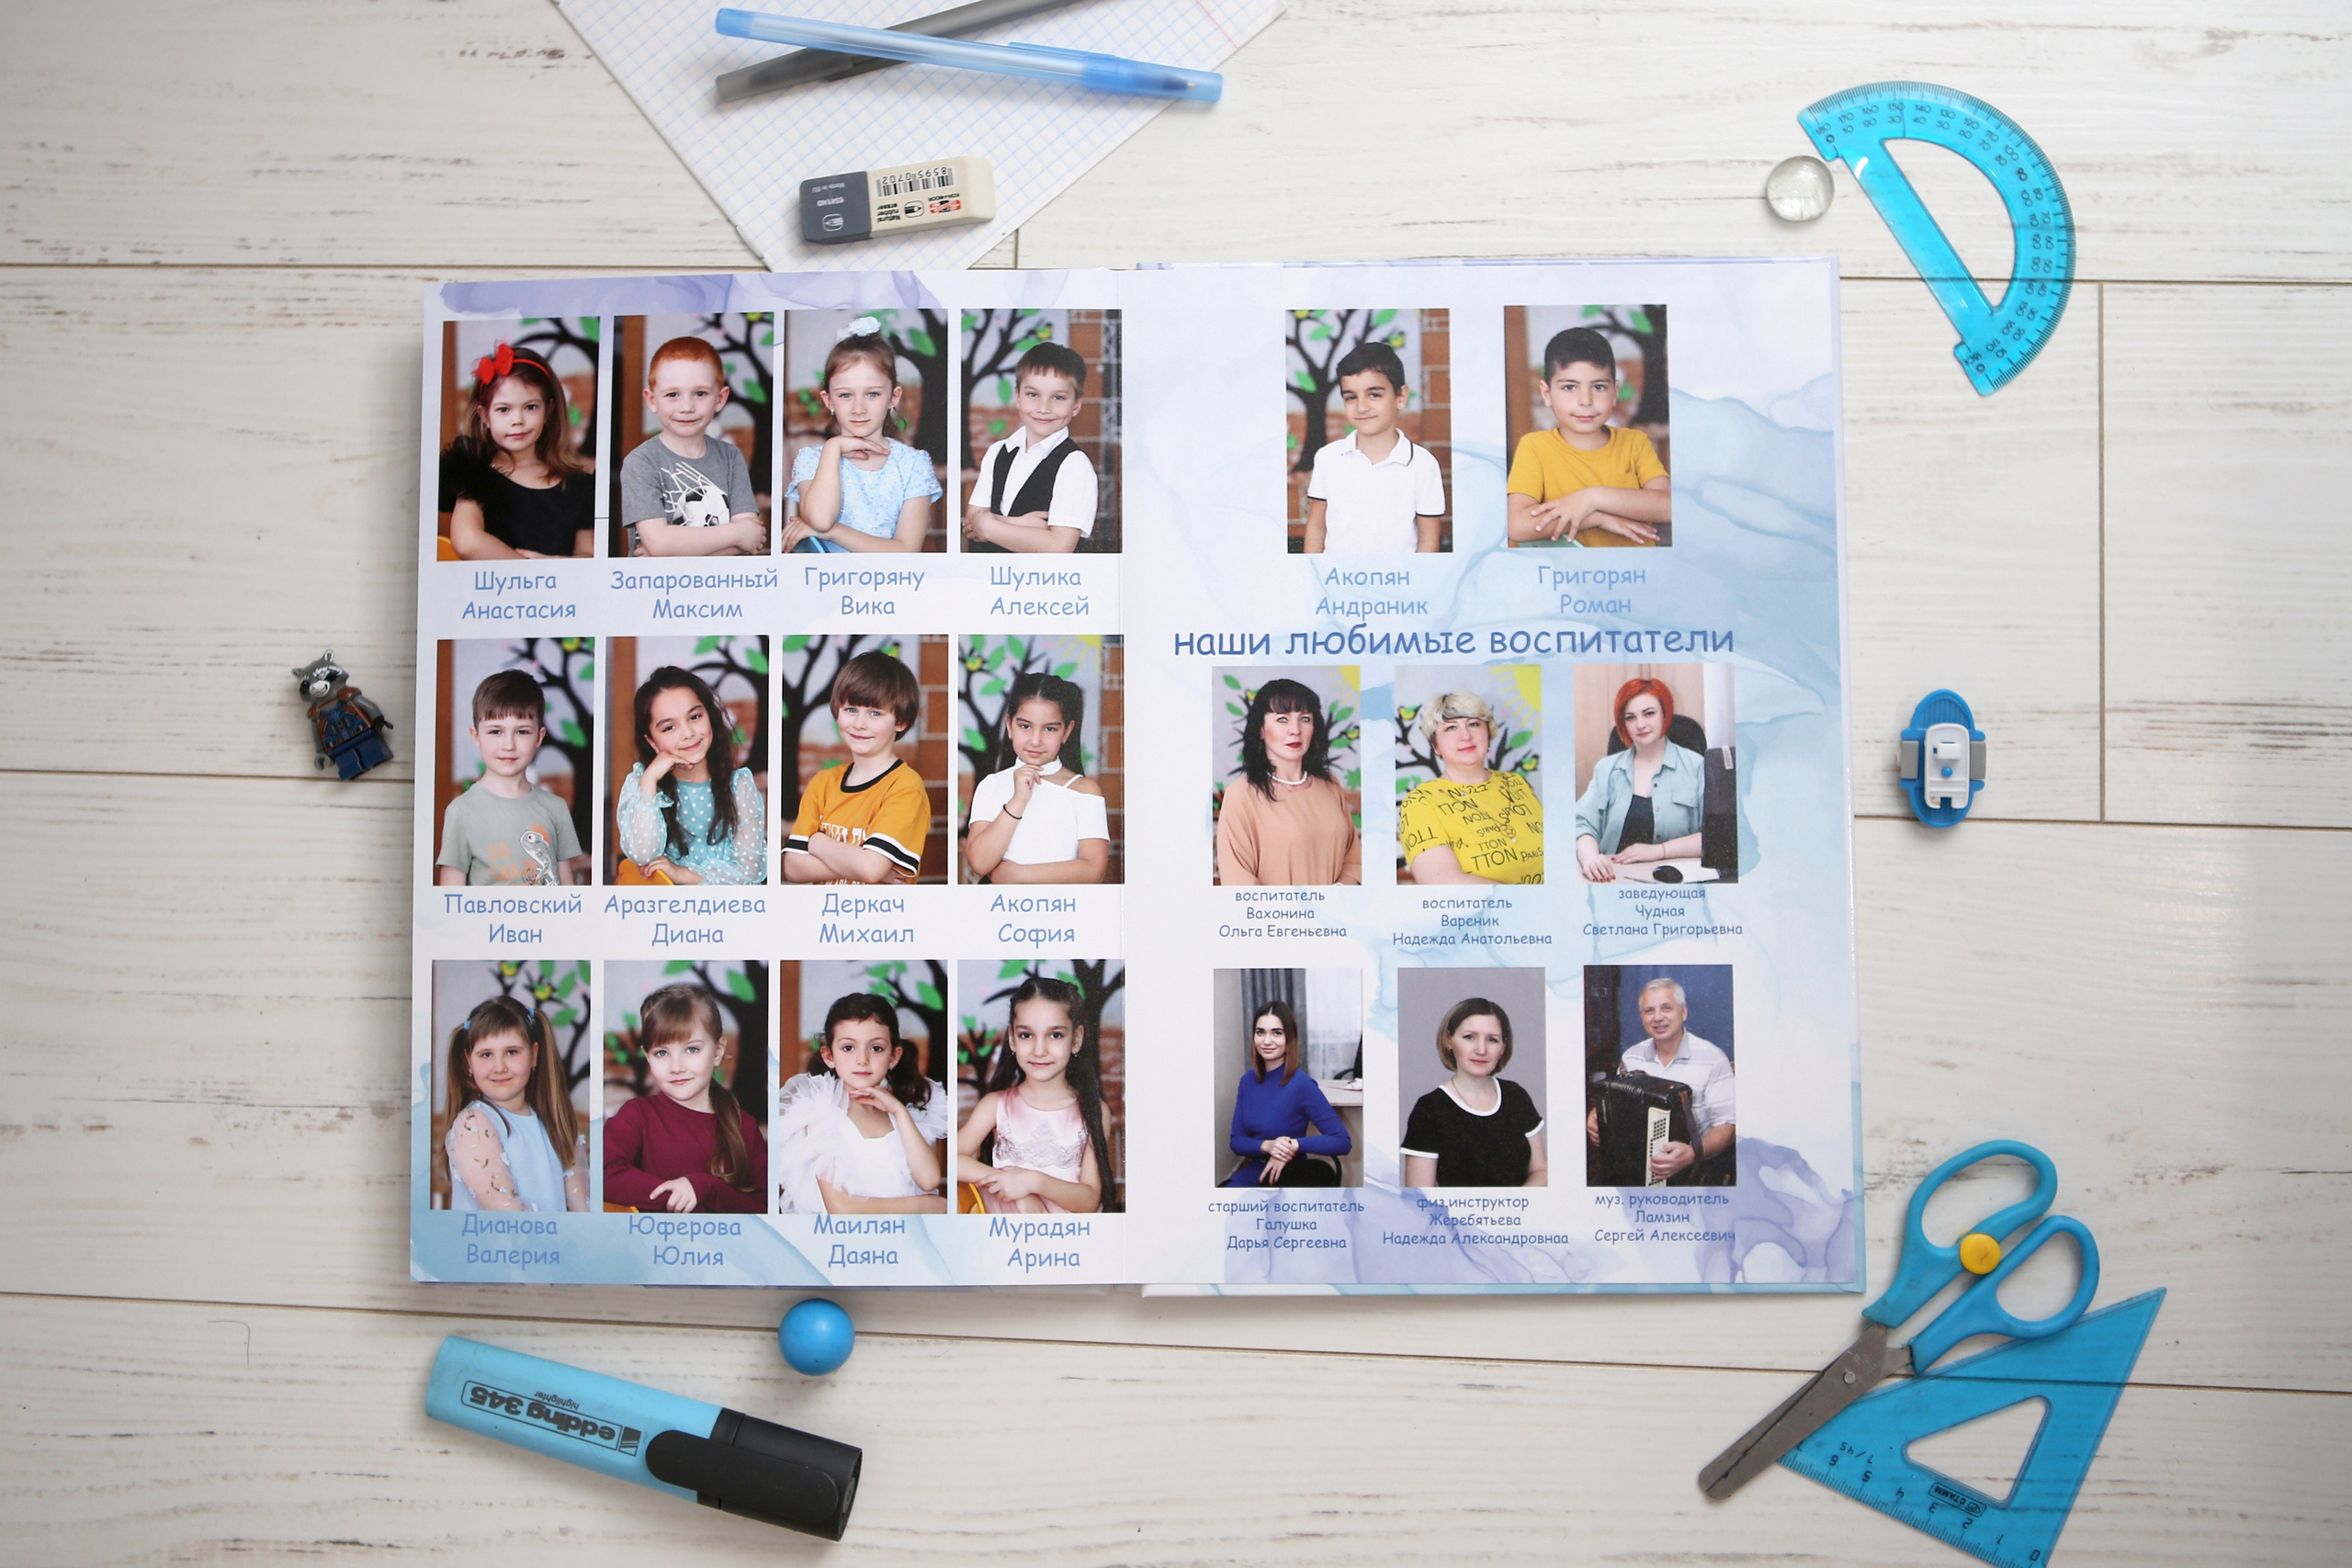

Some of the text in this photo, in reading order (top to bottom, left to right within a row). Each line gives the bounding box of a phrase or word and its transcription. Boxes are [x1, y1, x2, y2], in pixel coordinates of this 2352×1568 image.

[882, 167, 947, 184] 8595 0702
[877, 215, 900, 223] Natural
[1815, 102, 2054, 373] 180 170 160 150 140 130 120 110 100 90 80 70 60 50 40 30 20 10 0
[1826, 116, 2041, 365] 0 10 20 30 40 50 60 70 80 100 110 120 130 140 150 160 170 180
[475, 570, 557, 596] Шульга
[611, 570, 777, 595] Запарованный
[805, 567, 925, 592] Григоряну
[991, 566, 1081, 592] Шулика
[1324, 568, 1409, 586] Акопян
[1538, 566, 1645, 589] Григорян
[462, 601, 576, 619] Анастасия
[652, 599, 742, 619] Максим
[842, 595, 895, 615] Вика
[990, 595, 1089, 615] Алексей
[1316, 596, 1428, 620] Андраник
[1561, 594, 1631, 615] Роман
[1175, 623, 1734, 656] наши любимые воспитатели
[1477, 838, 1507, 851] TTON
[1471, 848, 1518, 871] TTON
[444, 893, 582, 914] Павловский
[990, 894, 1076, 912] Акопян
[1236, 892, 1325, 901] воспитатель
[1422, 899, 1512, 908] воспитатель
[1619, 889, 1705, 902] заведующая
[605, 895, 768, 919] Аразгелдиева
[821, 893, 904, 919] Деркач
[1247, 907, 1315, 919] Вахонина
[1635, 904, 1685, 920] Чудная
[1219, 924, 1347, 937] Ольга Евгеньевна
[1442, 915, 1499, 930] Вареник
[1583, 923, 1743, 938] Светлана Григорьевна
[489, 923, 542, 943] Иван
[651, 923, 724, 947] Диана
[820, 923, 914, 943] Михаил
[998, 923, 1075, 949] София
[1393, 932, 1552, 946] Надежда Анатольевна
[1208, 1200, 1364, 1215] старший воспитатель
[1595, 1195, 1729, 1209] муз. руководитель
[462, 1213, 558, 1236] Дианова
[814, 1214, 905, 1235] Маилян
[1256, 1218, 1317, 1234] Галушка
[1430, 1213, 1521, 1229] Жеребятьева
[1634, 1210, 1690, 1223] Ламзин
[629, 1215, 741, 1242] Юферова
[989, 1217, 1090, 1244] Мурадян
[1595, 1228, 1736, 1245] Сергей Алексеевич
[1227, 1235, 1347, 1252] Дарья Сергеевна
[1383, 1232, 1446, 1246] Надежда
[467, 1244, 560, 1270] Валерия
[654, 1246, 723, 1266] Юлия
[828, 1244, 899, 1269] Даяна
[1008, 1247, 1080, 1274] Арина
[534, 1391, 579, 1411] highlighter
[469, 1386, 616, 1440] edding 345
[1829, 1455, 1839, 1466] 6
[1862, 1471, 1872, 1483] 5
[1896, 1487, 1905, 1498] 4
[1934, 1486, 1966, 1505] СТАММ
[1929, 1502, 1938, 1514] 3
[1962, 1517, 1973, 1529] 2
[1996, 1534, 2004, 1544] 1
[2030, 1549, 2041, 1562] 0
